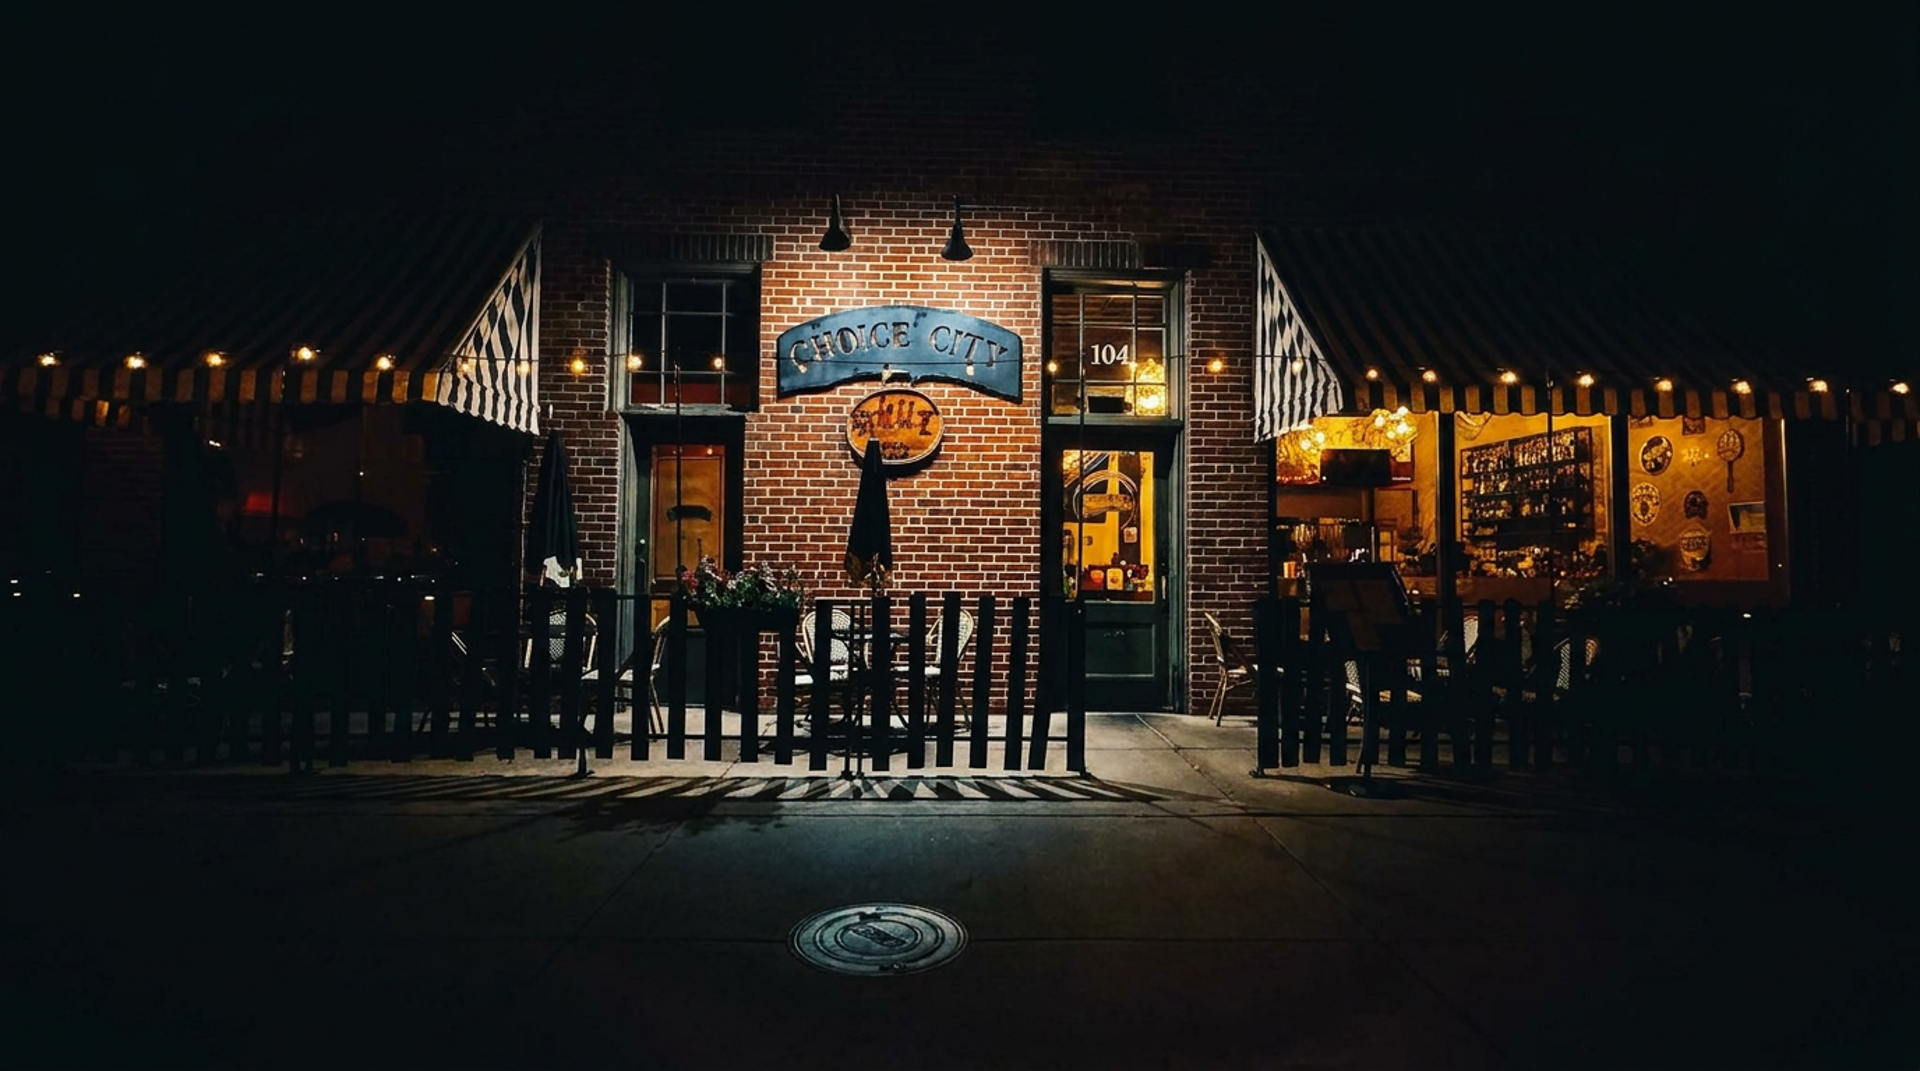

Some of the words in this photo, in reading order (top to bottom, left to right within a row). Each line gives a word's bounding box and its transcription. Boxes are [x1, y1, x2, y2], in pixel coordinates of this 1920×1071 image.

[789, 321, 911, 371] CHOICE
[929, 325, 1009, 368] CITY
[1090, 344, 1130, 366] 104
